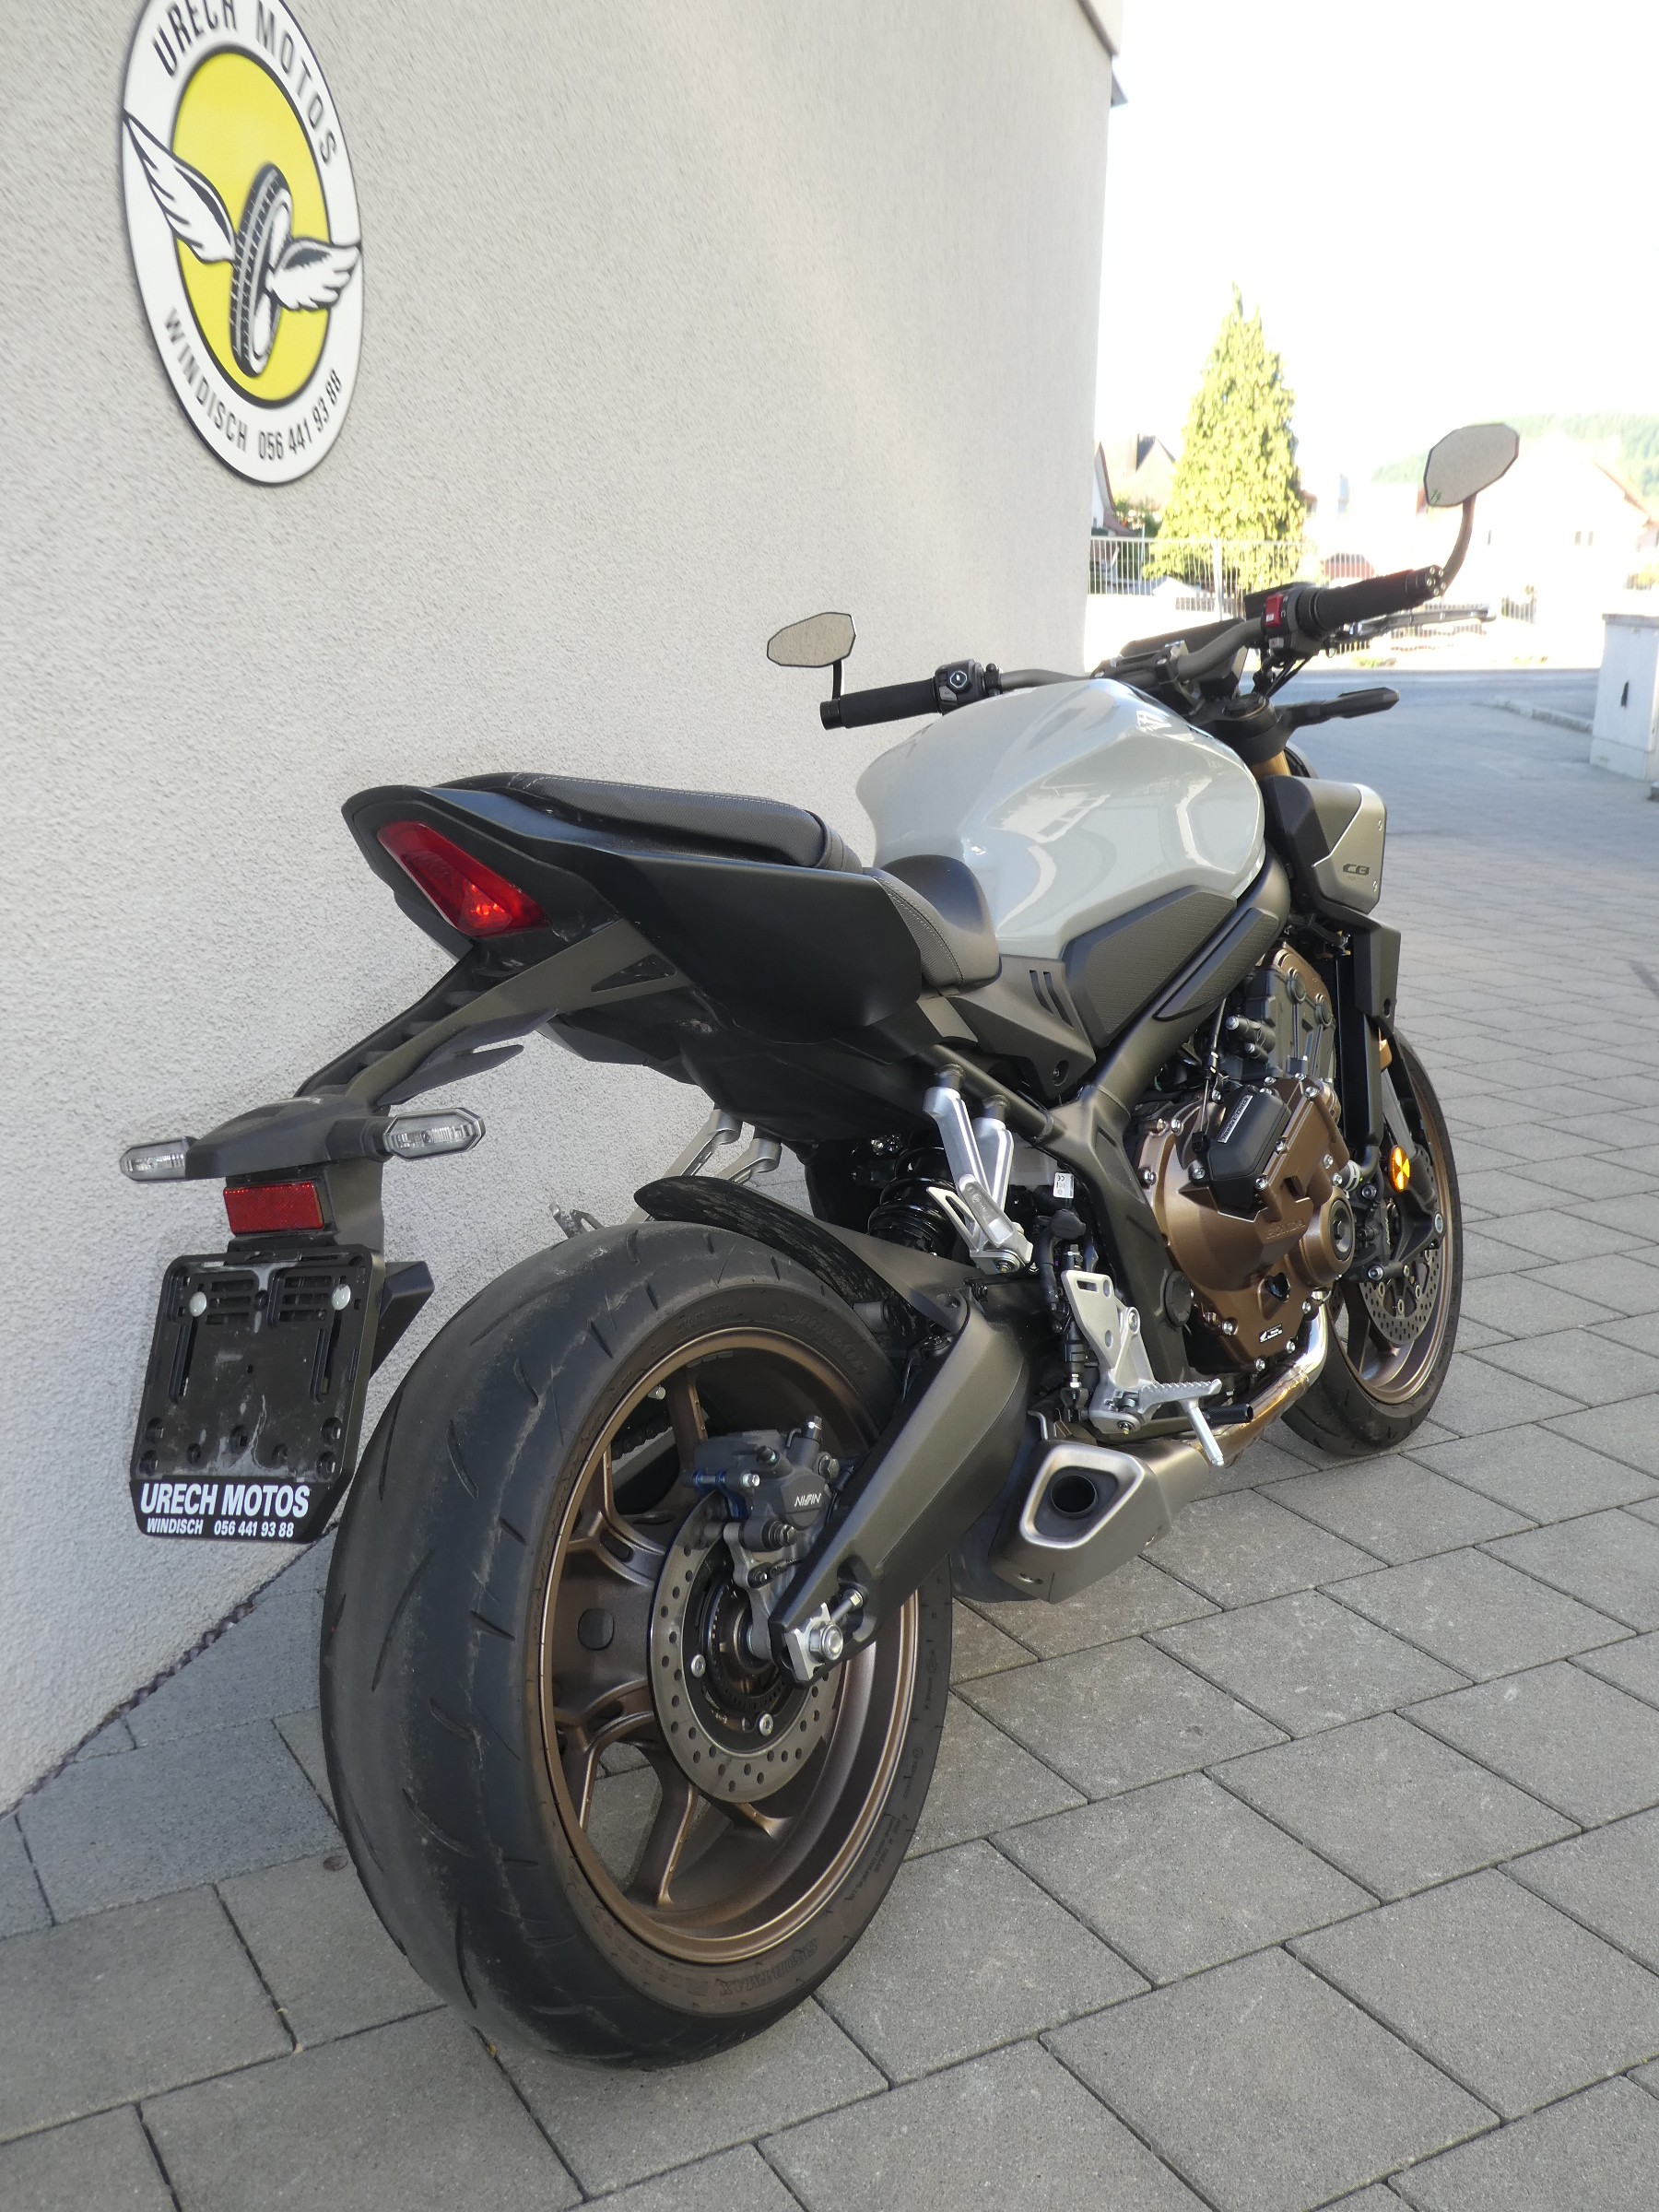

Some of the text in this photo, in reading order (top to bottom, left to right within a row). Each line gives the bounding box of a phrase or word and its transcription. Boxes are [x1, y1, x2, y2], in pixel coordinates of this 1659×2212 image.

[152, 0, 336, 164] URECH MOTOS
[164, 305, 343, 461] WINDISCH 056 441 93 88
[1342, 863, 1371, 877] CB
[140, 1483, 311, 1518] URECH MOTOS
[147, 1518, 295, 1538] WINDISCH 056 441 93 88
